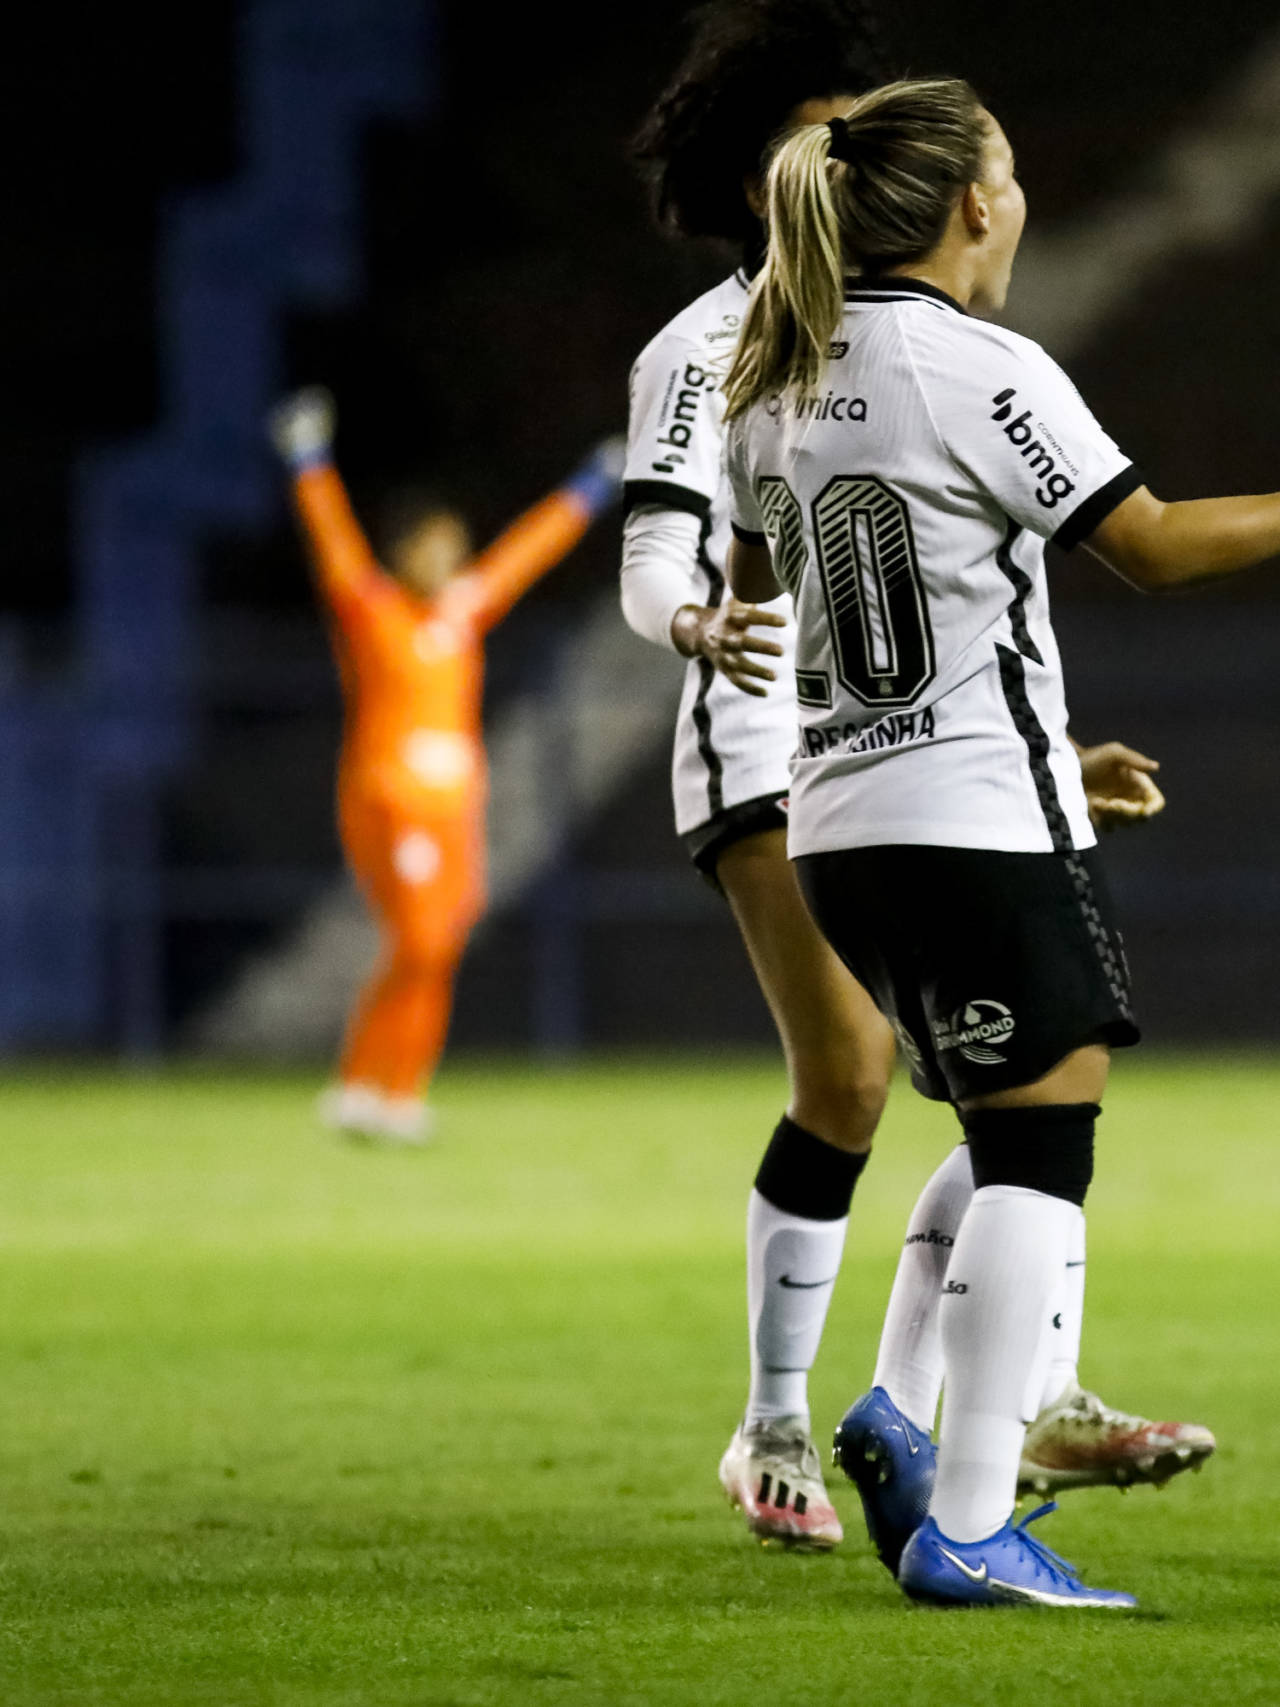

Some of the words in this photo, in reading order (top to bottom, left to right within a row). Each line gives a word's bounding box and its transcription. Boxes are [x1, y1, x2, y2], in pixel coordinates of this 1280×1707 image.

[656, 363, 715, 449] bmg
[1036, 421, 1080, 477] CORINTHIANS
[1002, 409, 1076, 509] bmg
[757, 474, 937, 709] 20
